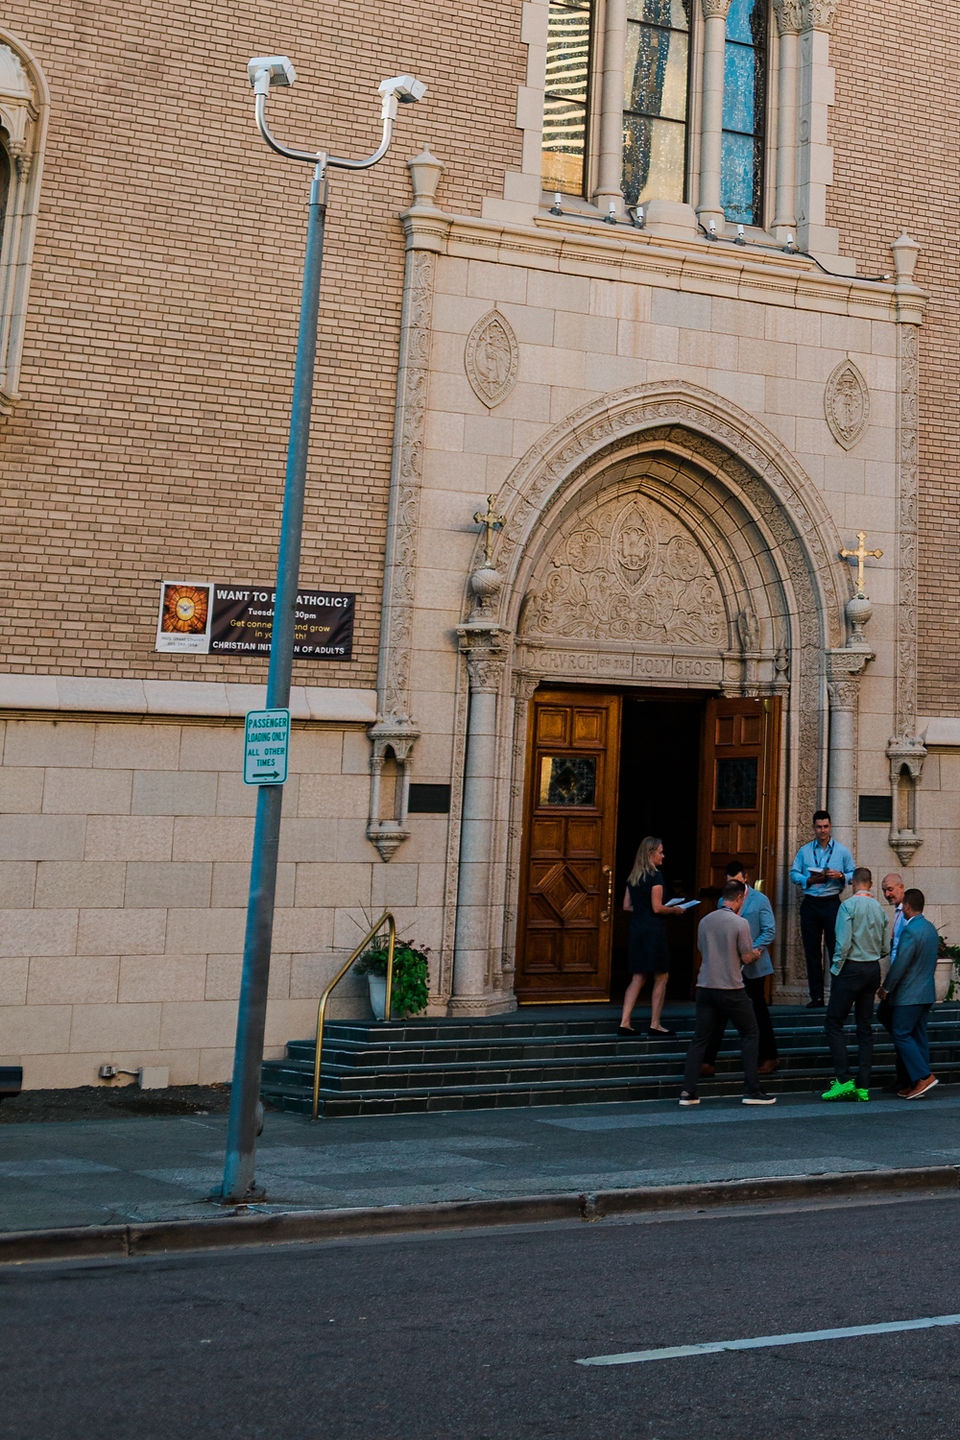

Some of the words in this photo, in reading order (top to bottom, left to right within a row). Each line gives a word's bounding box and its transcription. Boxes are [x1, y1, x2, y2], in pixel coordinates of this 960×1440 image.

[217, 590, 249, 601] WANT
[252, 592, 268, 602] TO
[296, 595, 348, 607] ATHOLIC?
[295, 611, 316, 620] 30pm
[230, 619, 245, 627] Get
[309, 625, 331, 633] grow
[212, 641, 256, 650] CHRISTIAN
[315, 646, 345, 655] ADULTS
[635, 658, 670, 674] HOLY
[674, 661, 721, 677] GHOST
[248, 717, 287, 729] PASSENGER
[247, 732, 271, 742] LOADING
[272, 731, 286, 741] ONLY
[248, 749, 260, 757] ALL
[264, 747, 285, 756] OTHER
[256, 758, 276, 767] TIMES
